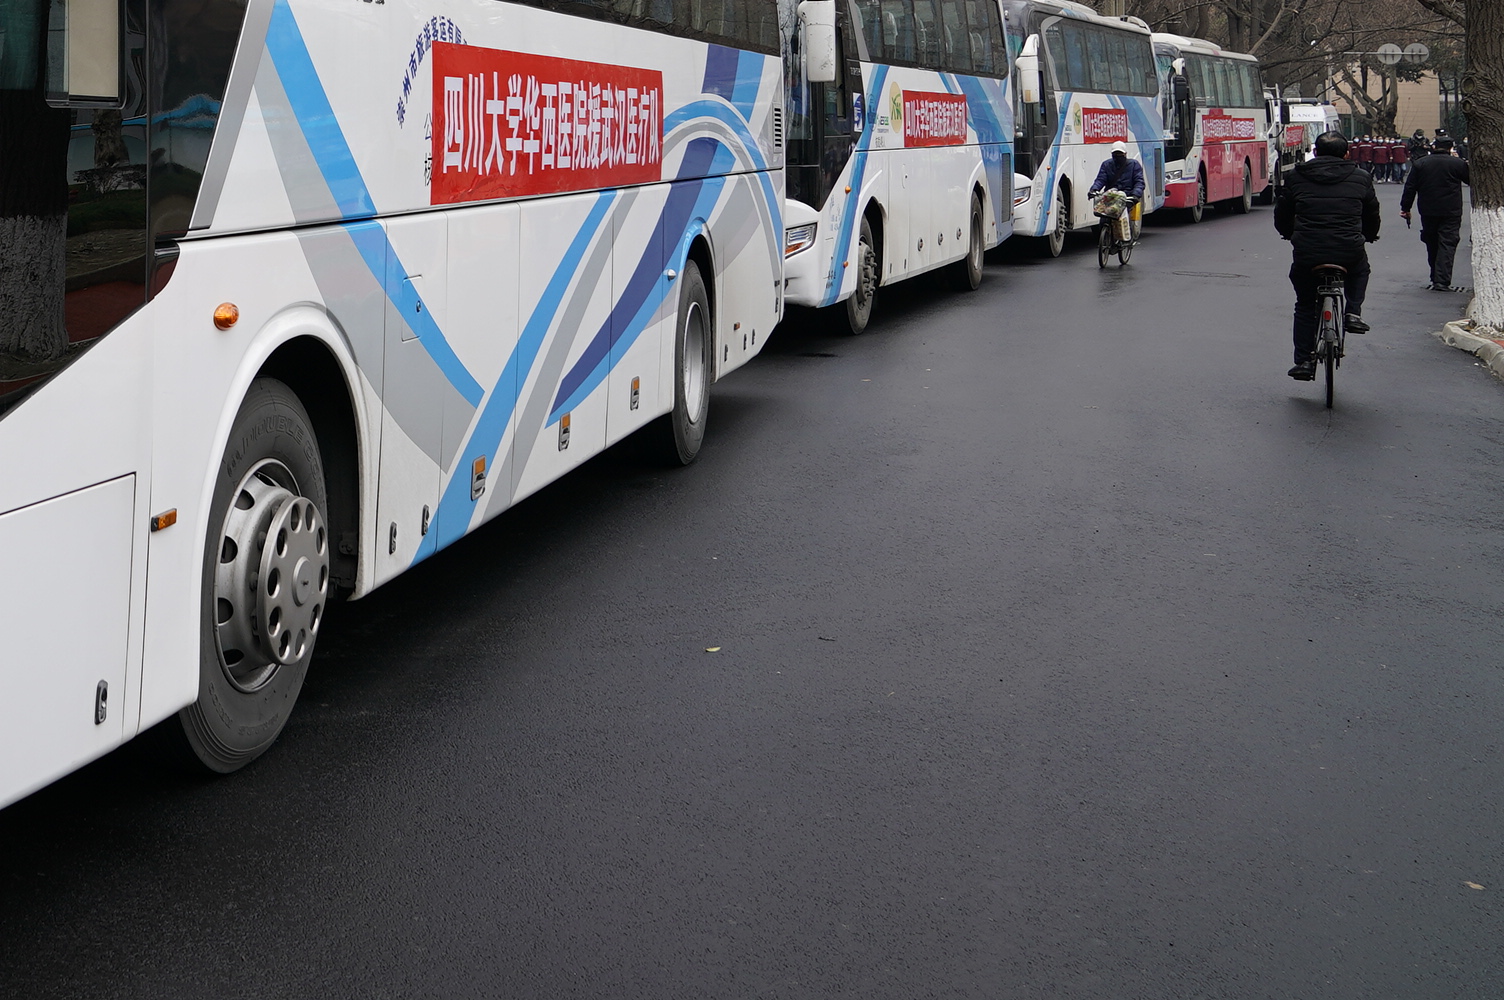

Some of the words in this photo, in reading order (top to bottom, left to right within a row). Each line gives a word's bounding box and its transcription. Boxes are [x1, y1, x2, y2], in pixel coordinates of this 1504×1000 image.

[442, 71, 661, 178] 四川大学华西医院援武汉医疗队
